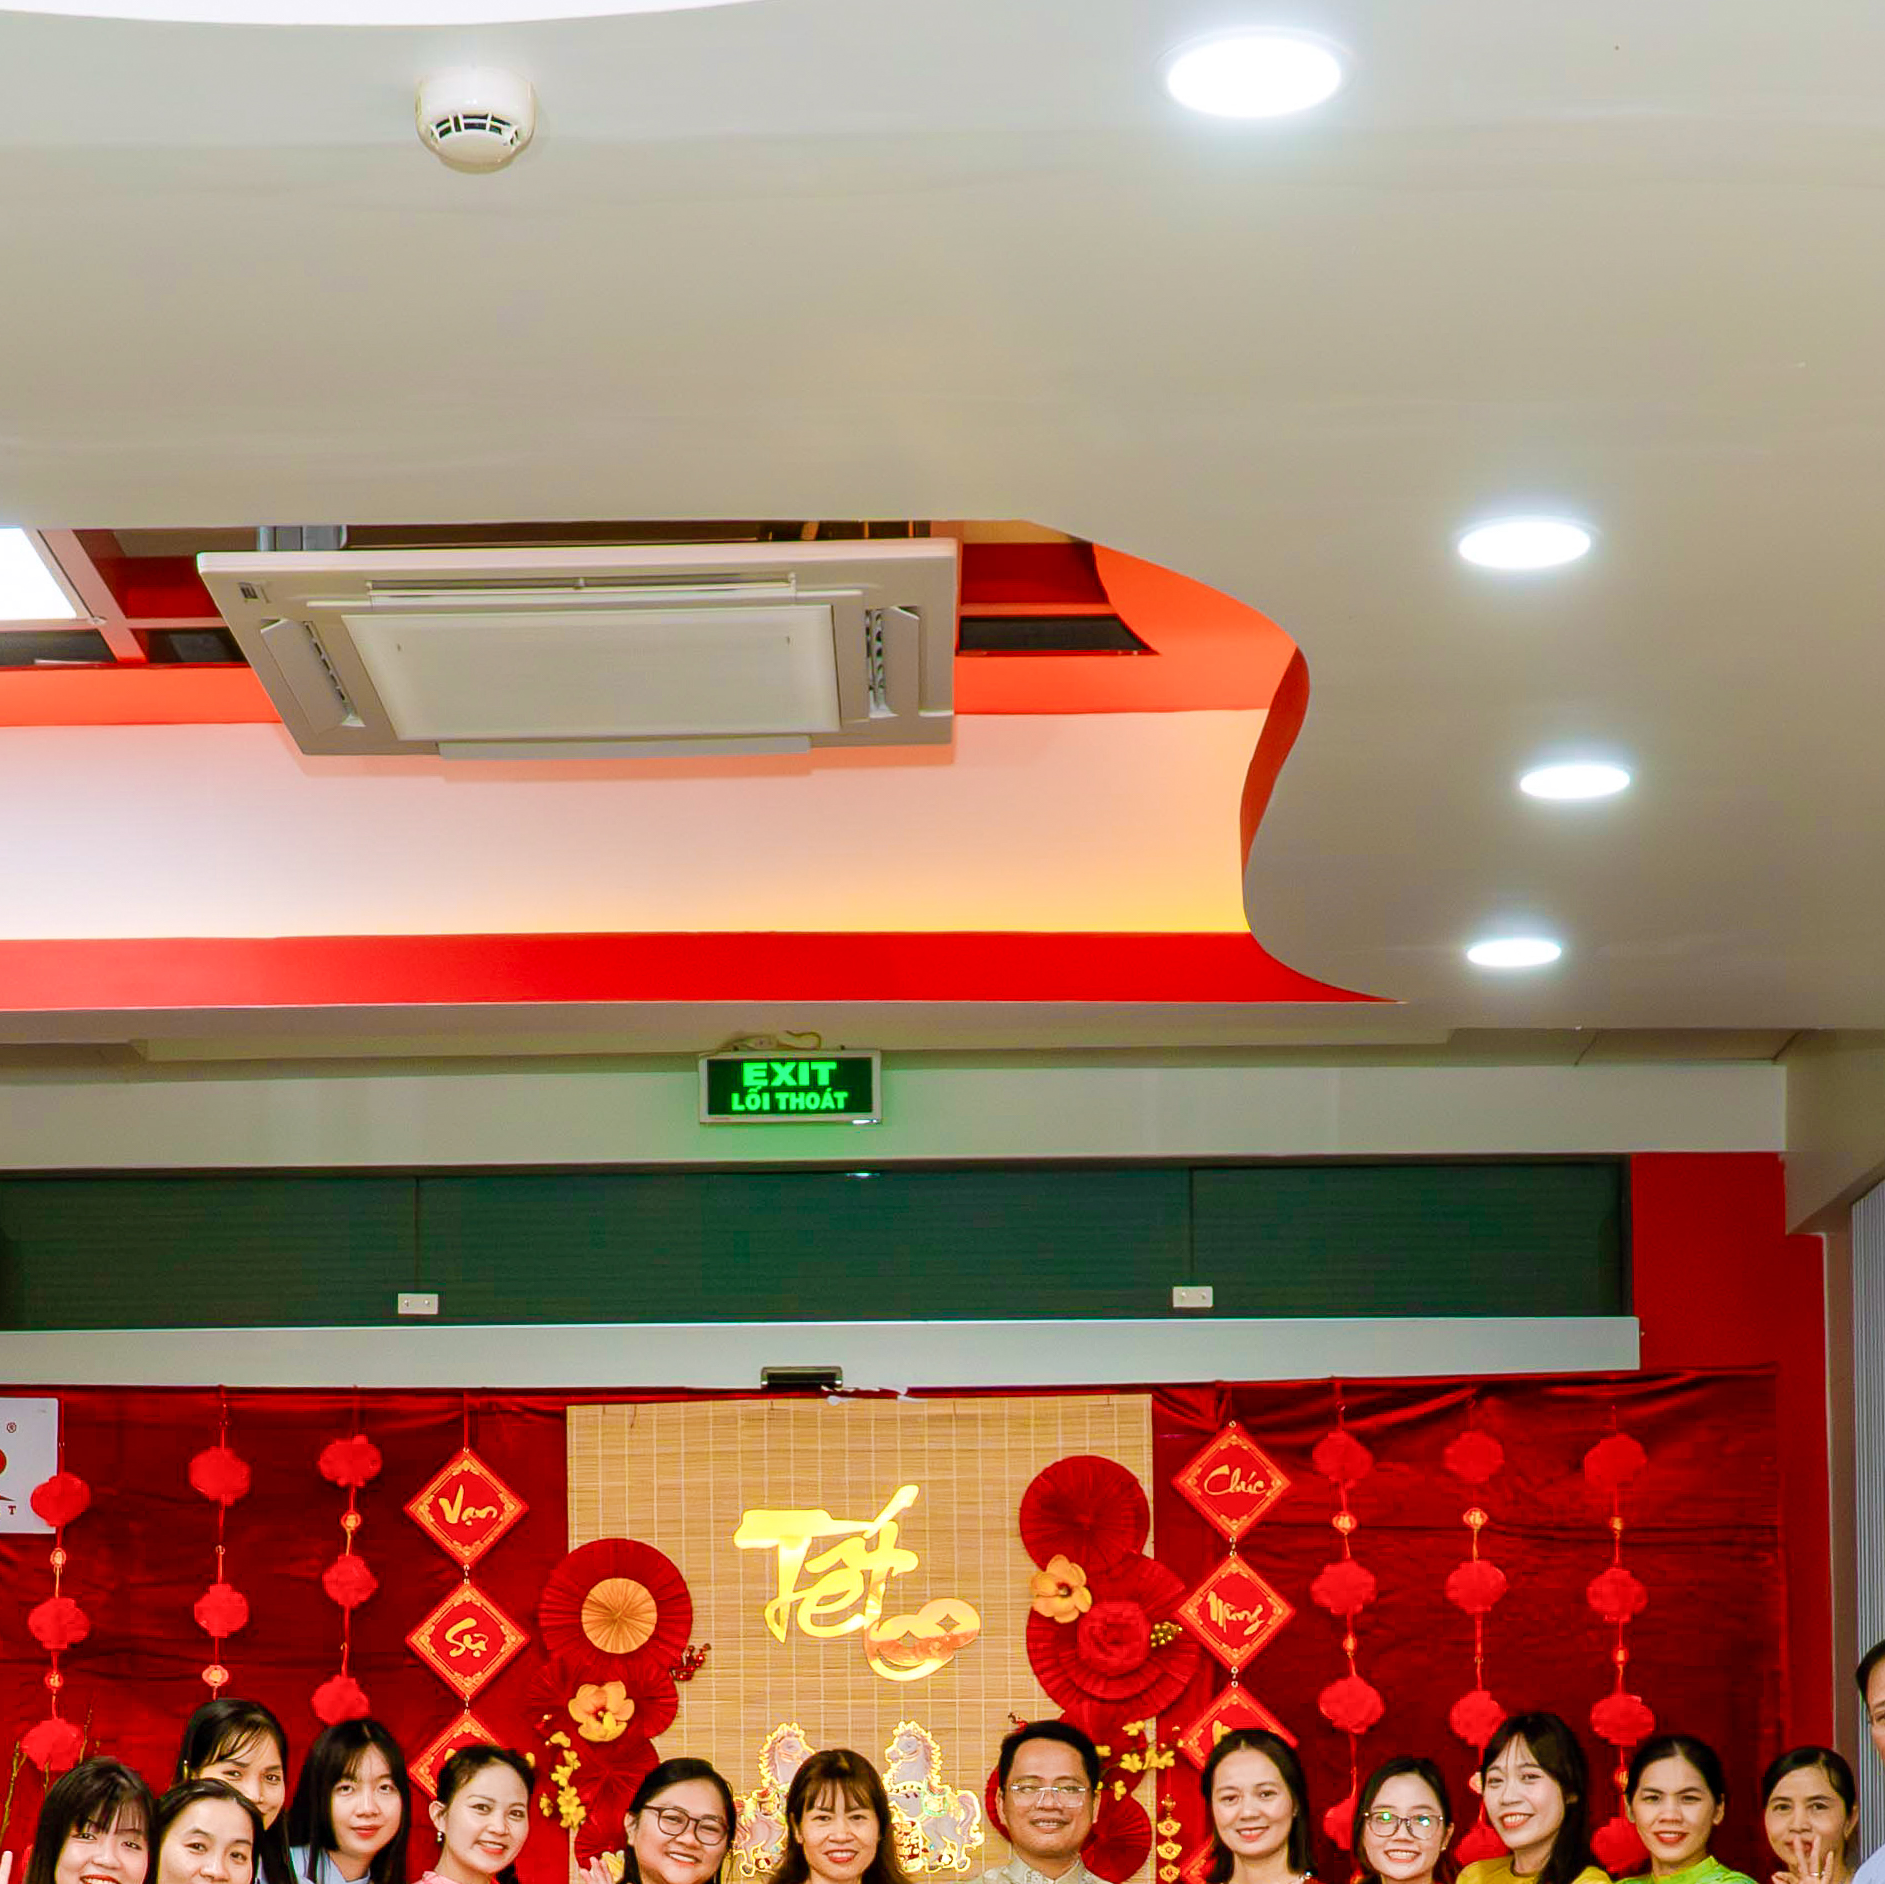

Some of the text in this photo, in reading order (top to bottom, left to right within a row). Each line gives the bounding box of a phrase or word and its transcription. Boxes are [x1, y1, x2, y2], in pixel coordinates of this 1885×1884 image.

[743, 1061, 837, 1087] EXIT
[731, 1086, 849, 1111] LỐI THOÁT
[1204, 1463, 1267, 1495] Chúc
[438, 1484, 498, 1525] Vạn
[733, 1484, 920, 1644] Tết
[444, 1617, 489, 1658] Sự
